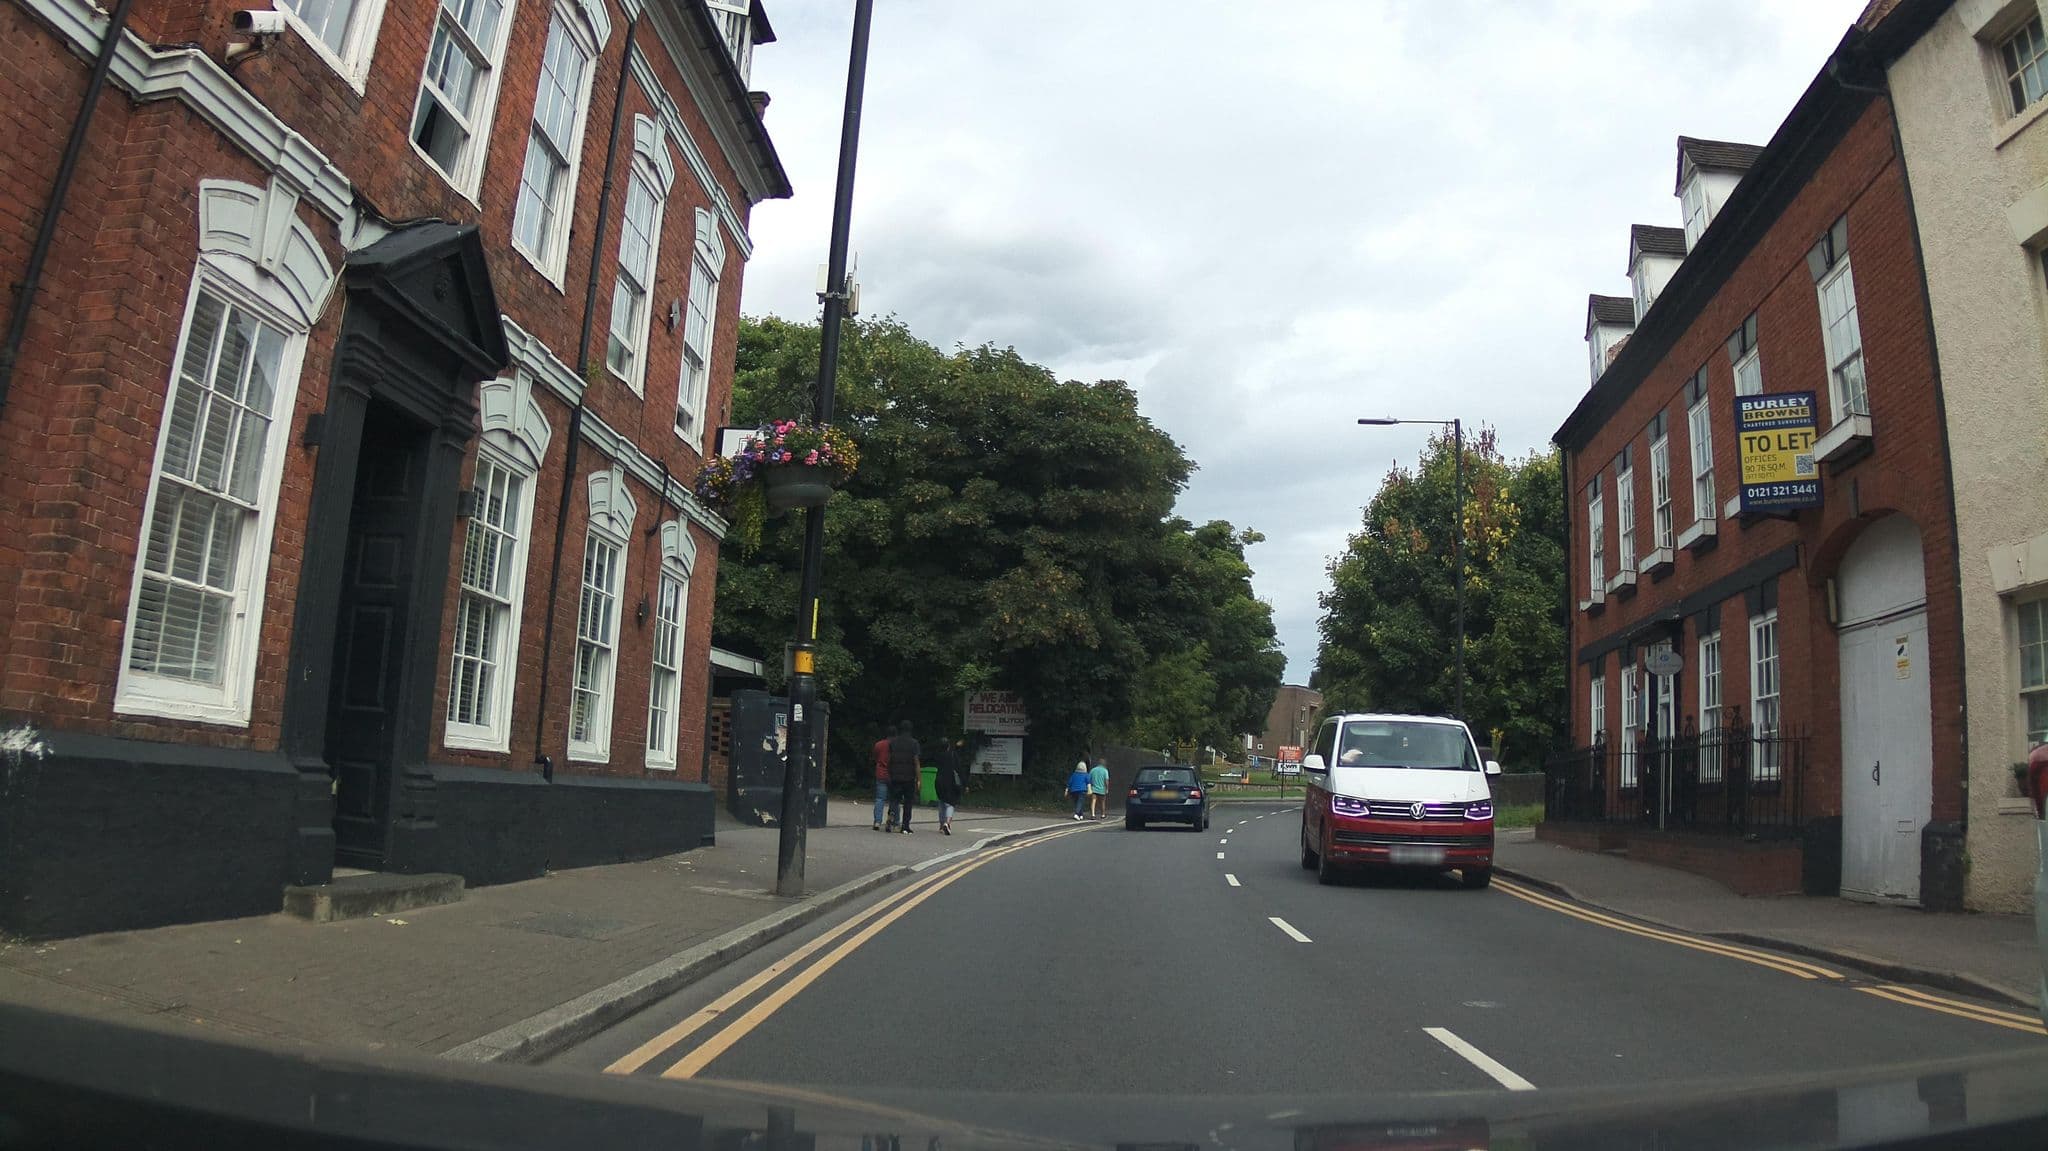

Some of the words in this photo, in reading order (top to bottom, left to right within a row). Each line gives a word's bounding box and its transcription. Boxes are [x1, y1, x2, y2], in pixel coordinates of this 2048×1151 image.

[1742, 398, 1808, 410] BURLEY
[1744, 407, 1809, 420] BROWNE
[1744, 435, 1771, 453] TO
[1777, 431, 1812, 451] LET
[1745, 454, 1777, 464] OFFICES
[1748, 487, 1770, 498] 0121
[1773, 486, 1790, 496] 321
[1792, 484, 1817, 495] 3441
[980, 692, 998, 703] WE
